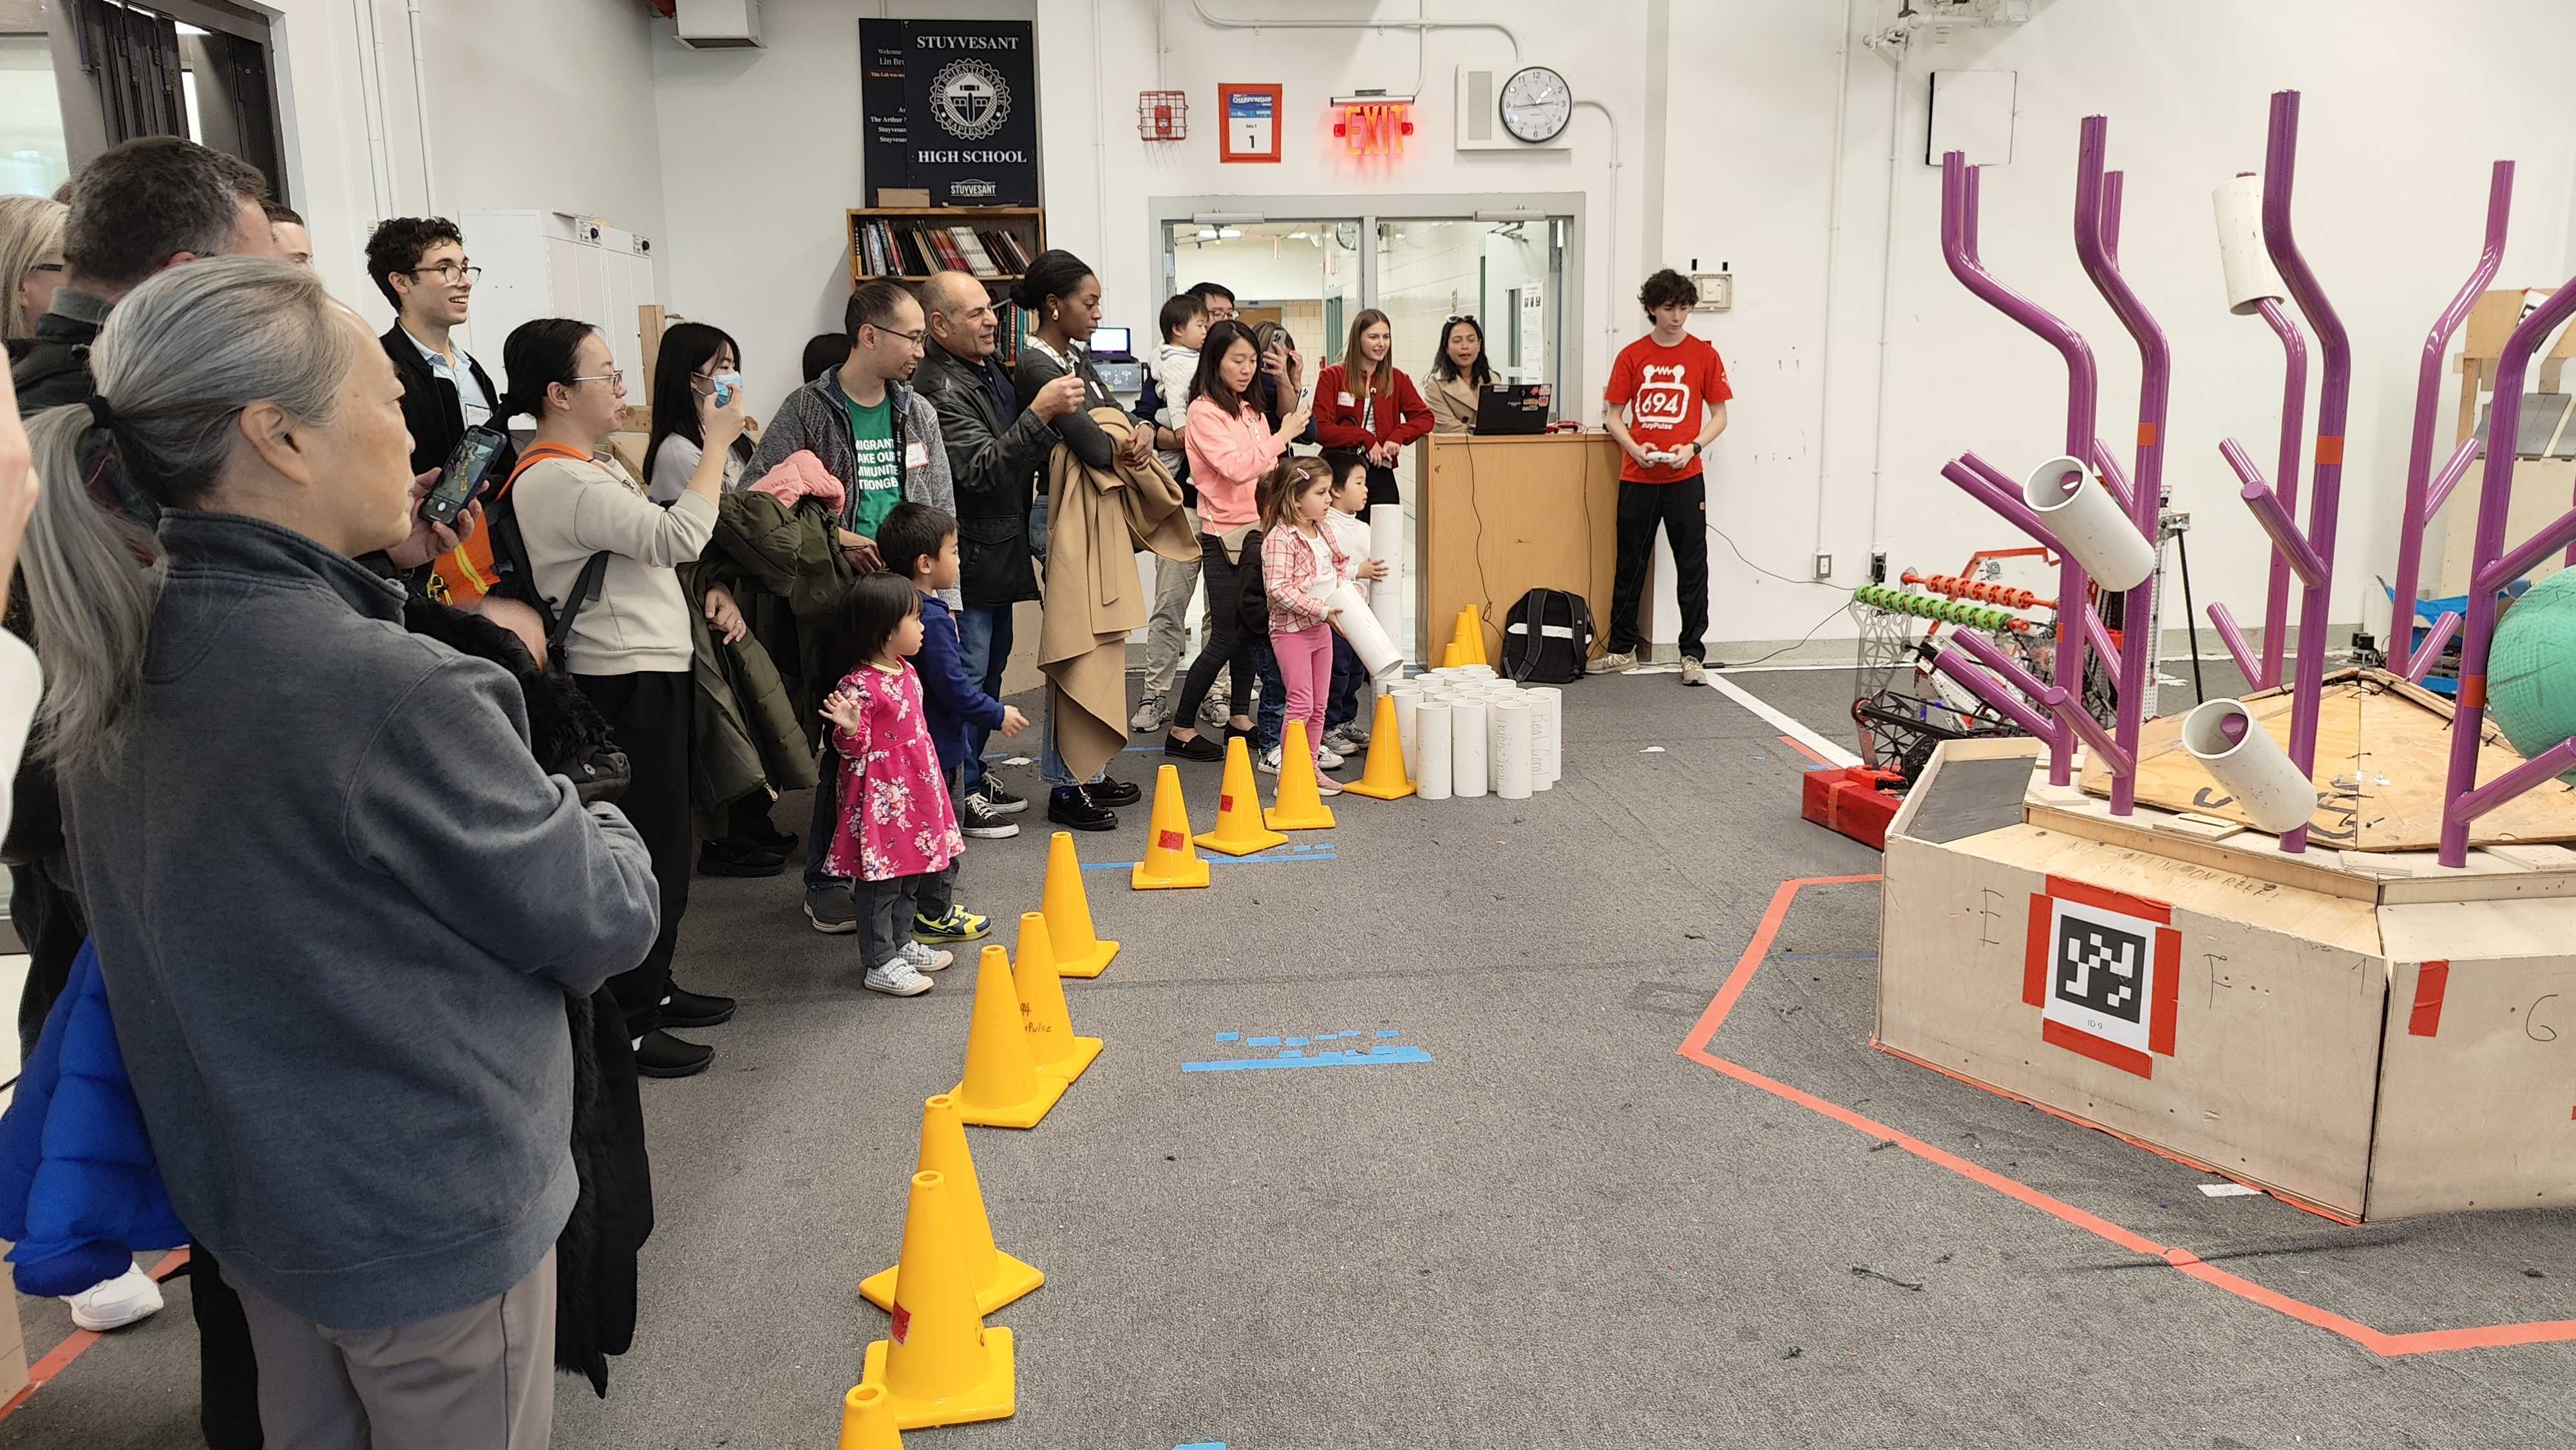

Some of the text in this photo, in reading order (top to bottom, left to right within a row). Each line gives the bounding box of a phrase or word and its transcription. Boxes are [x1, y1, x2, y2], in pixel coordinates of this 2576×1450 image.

[916, 36, 1019, 50] STUYVESANT
[1519, 75, 1525, 84] 11
[936, 65, 1005, 135] PRO SCIENTIA ATQUE SAPIENTIA
[1344, 105, 1406, 155] EXIT
[1249, 135, 1255, 149] 1
[917, 150, 1027, 163] HIGH SCHOOL
[950, 184, 996, 194] STUYVESANT
[1642, 392, 1679, 413] 694
[855, 438, 895, 451] MIGRANT
[857, 453, 876, 464] AKE
[2189, 869, 2218, 881] ON
[1020, 1003, 1032, 1017] 94
[1025, 1021, 1052, 1033] Pulse
[2087, 1019, 2096, 1028] ID
